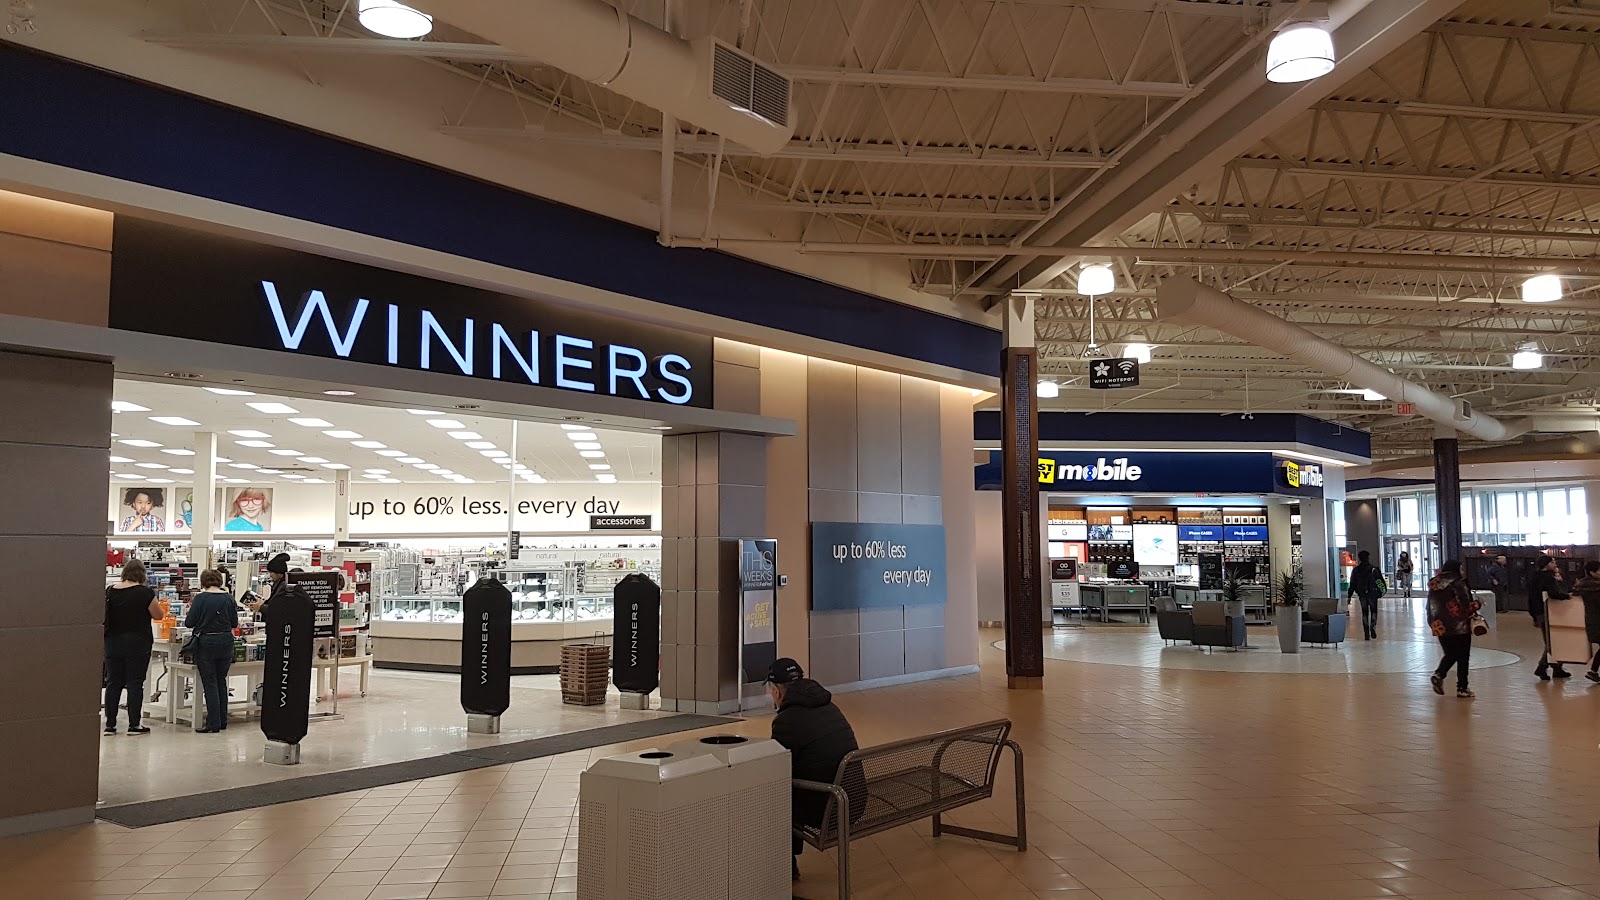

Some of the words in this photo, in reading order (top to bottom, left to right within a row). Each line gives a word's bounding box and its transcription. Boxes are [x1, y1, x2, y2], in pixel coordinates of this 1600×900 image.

[262, 281, 693, 404] WINNERS
[1397, 403, 1411, 414] EXIT
[1058, 458, 1142, 481] mobile
[1300, 465, 1323, 487] mobile
[349, 501, 374, 519] up
[383, 498, 405, 515] to
[413, 496, 454, 515] 60%
[462, 496, 508, 515] less.
[517, 500, 577, 518] every
[583, 496, 620, 514] day
[596, 516, 646, 526] accessories
[600, 551, 621, 559] natural
[833, 543, 848, 563] up
[850, 542, 863, 559] to
[865, 541, 885, 559] 60%
[887, 541, 906, 558] less
[883, 569, 913, 587] every
[914, 566, 931, 586] day
[746, 612, 767, 620] ACTIVE
[755, 602, 770, 612] GET
[630, 602, 639, 667] WINNERS
[481, 611, 489, 685] WINNERS
[279, 624, 291, 708] WINNERS
